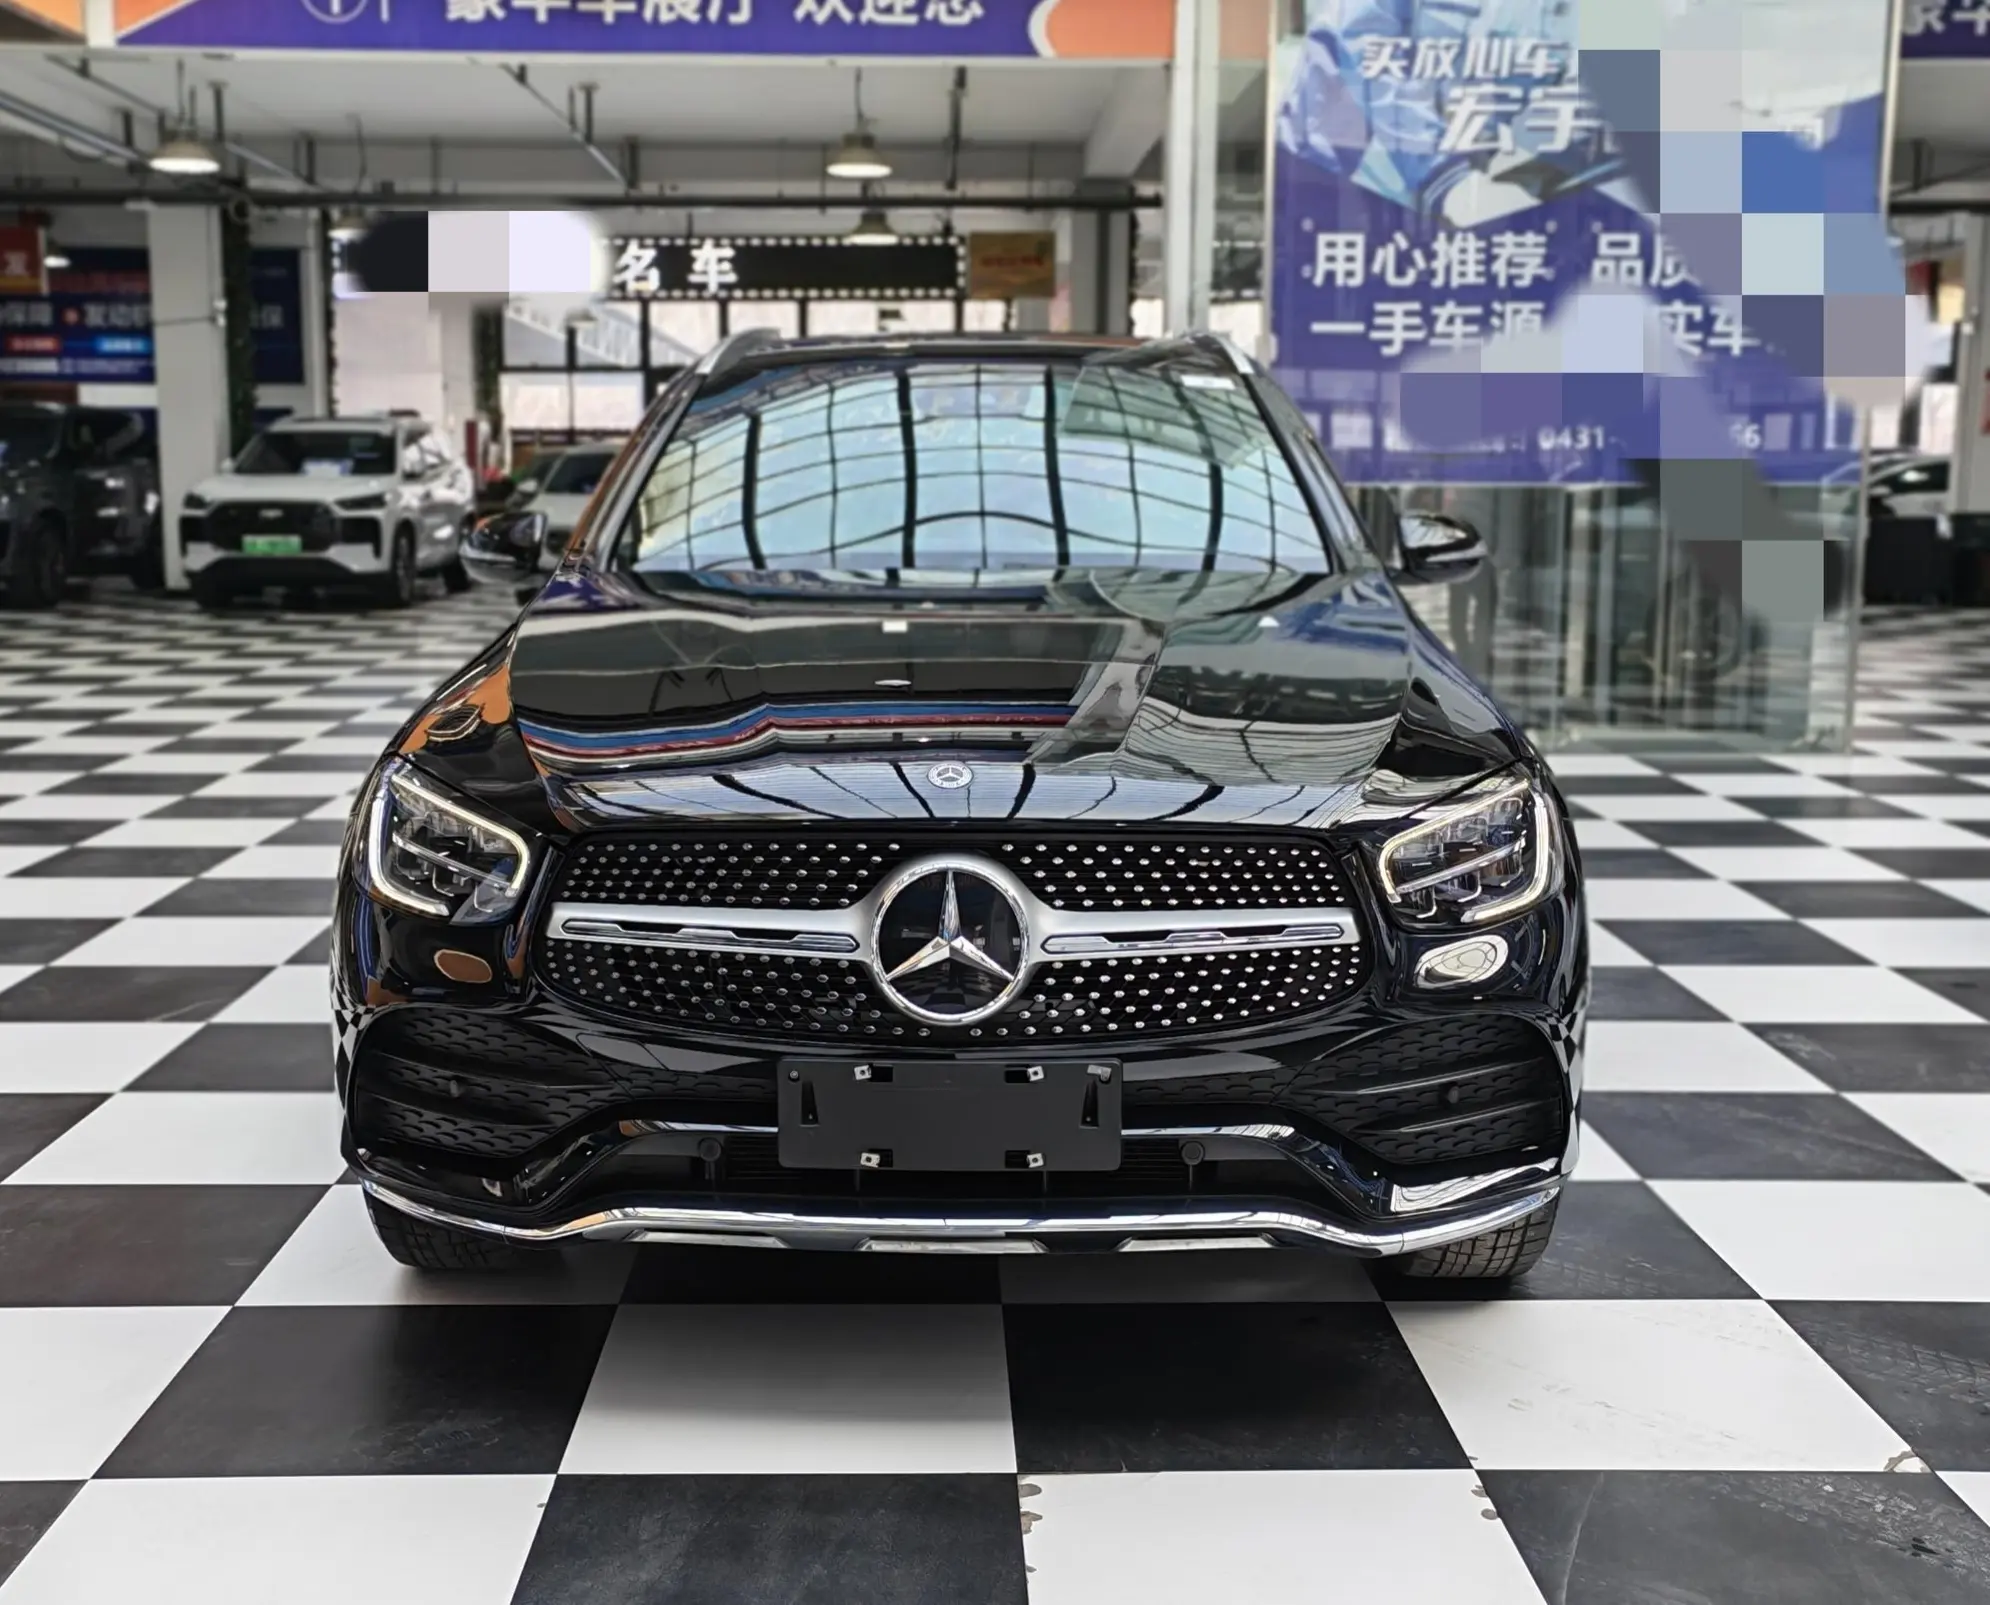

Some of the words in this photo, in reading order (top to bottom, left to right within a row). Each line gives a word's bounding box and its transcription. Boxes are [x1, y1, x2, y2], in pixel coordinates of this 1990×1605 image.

[1361, 35, 1578, 79] 买放心车
[1438, 83, 1612, 155] 宏宇
[612, 238, 738, 294] 名车
[1312, 232, 1547, 288] 用心推荐
